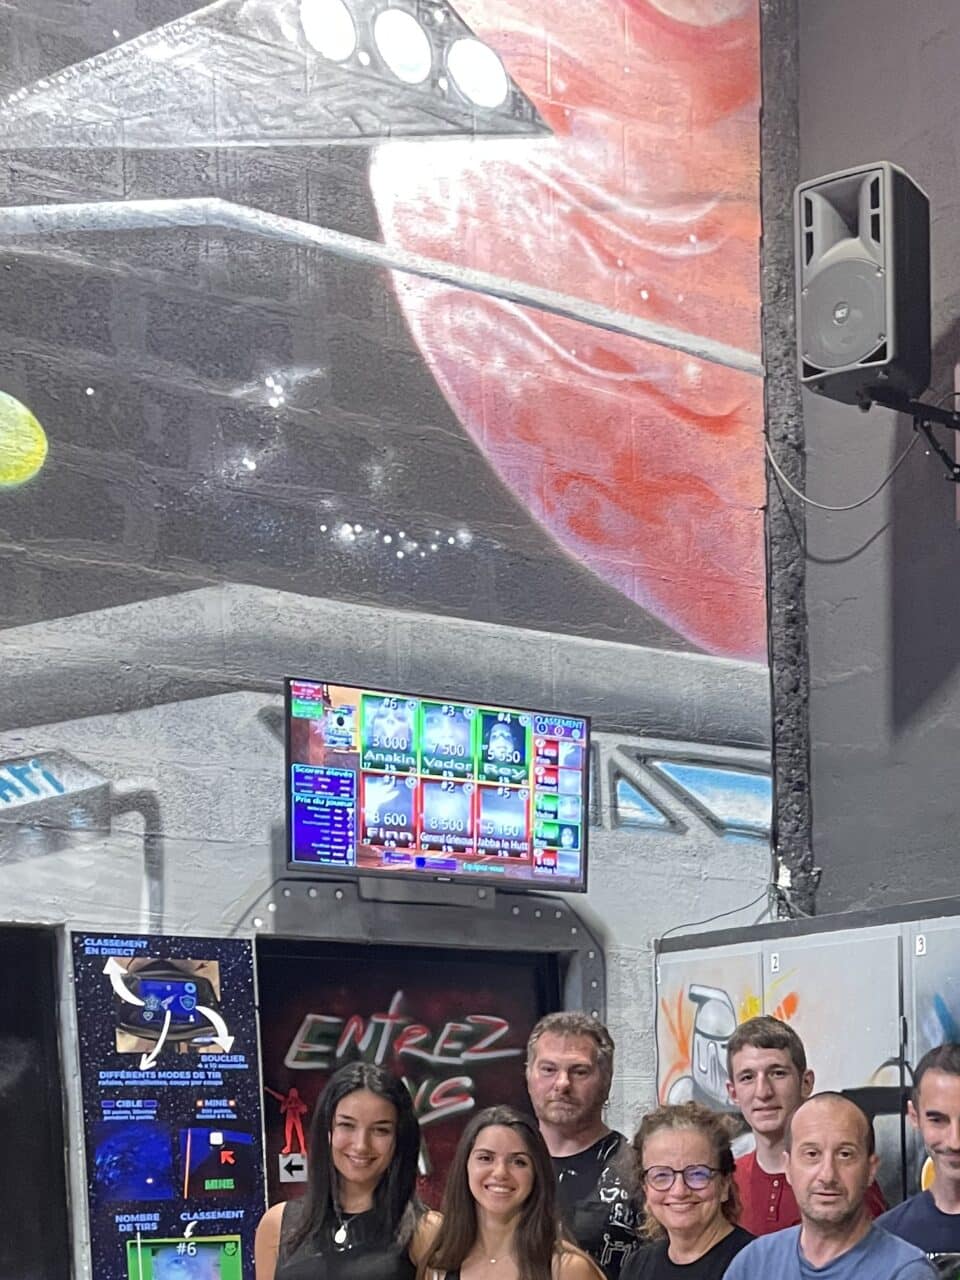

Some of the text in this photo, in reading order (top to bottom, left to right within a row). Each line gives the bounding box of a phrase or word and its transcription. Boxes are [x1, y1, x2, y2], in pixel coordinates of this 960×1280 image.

[384, 698, 398, 710] #6
[441, 705, 455, 717] #3
[498, 712, 511, 724] #4
[535, 716, 583, 729] CLASSEMENT
[364, 750, 416, 764] Anakin
[423, 756, 472, 771] Vador
[483, 762, 527, 780] Rey
[384, 775, 396, 787] #1
[440, 781, 454, 793] #2
[497, 787, 510, 799] #5
[367, 827, 414, 842] Finn
[478, 837, 500, 848] Jabba
[84, 938, 148, 949] CLASSEMENT
[917, 937, 925, 953] 3
[85, 947, 136, 957] EN DIRECT
[772, 955, 779, 970] 2
[201, 1054, 246, 1063] BOUCLIER
[99, 1069, 222, 1080] DIFFÉRENTS MODES DE TIR
[116, 1099, 143, 1108] CIBLE
[204, 1099, 229, 1108] MINE
[205, 1178, 235, 1190] MINE
[115, 1213, 160, 1223] NOMBRE
[180, 1210, 245, 1221] CLASSEMENT
[118, 1222, 158, 1232] DE TIRS
[176, 1242, 197, 1256] #6
